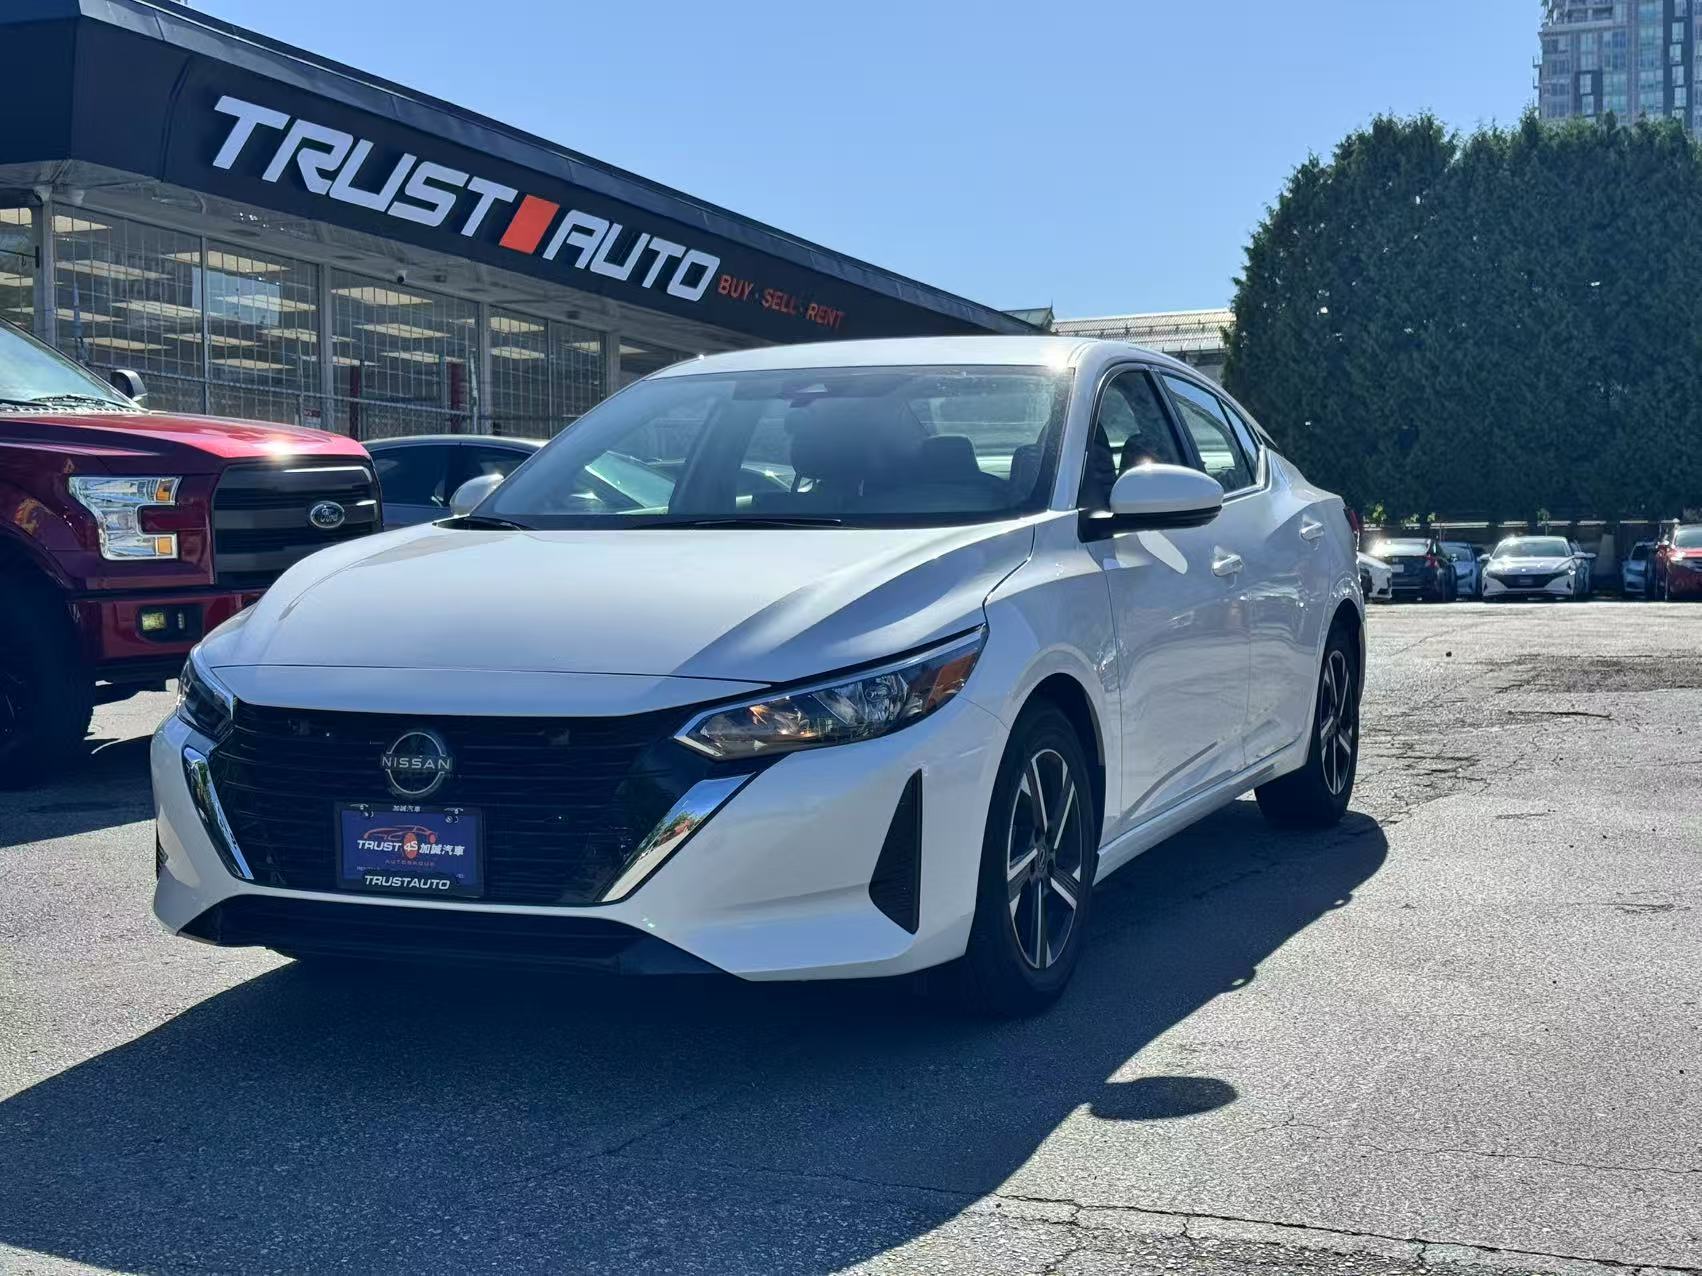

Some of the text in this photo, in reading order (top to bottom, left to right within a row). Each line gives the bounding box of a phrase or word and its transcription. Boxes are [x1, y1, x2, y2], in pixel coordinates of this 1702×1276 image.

[212, 94, 721, 302] TRUST AUTO
[718, 275, 846, 328] BUY SELL RENT
[382, 756, 450, 770] NISSAN
[357, 839, 401, 852] TRUST
[404, 840, 419, 852] 4S
[364, 874, 450, 890] TRUSTAUTO
